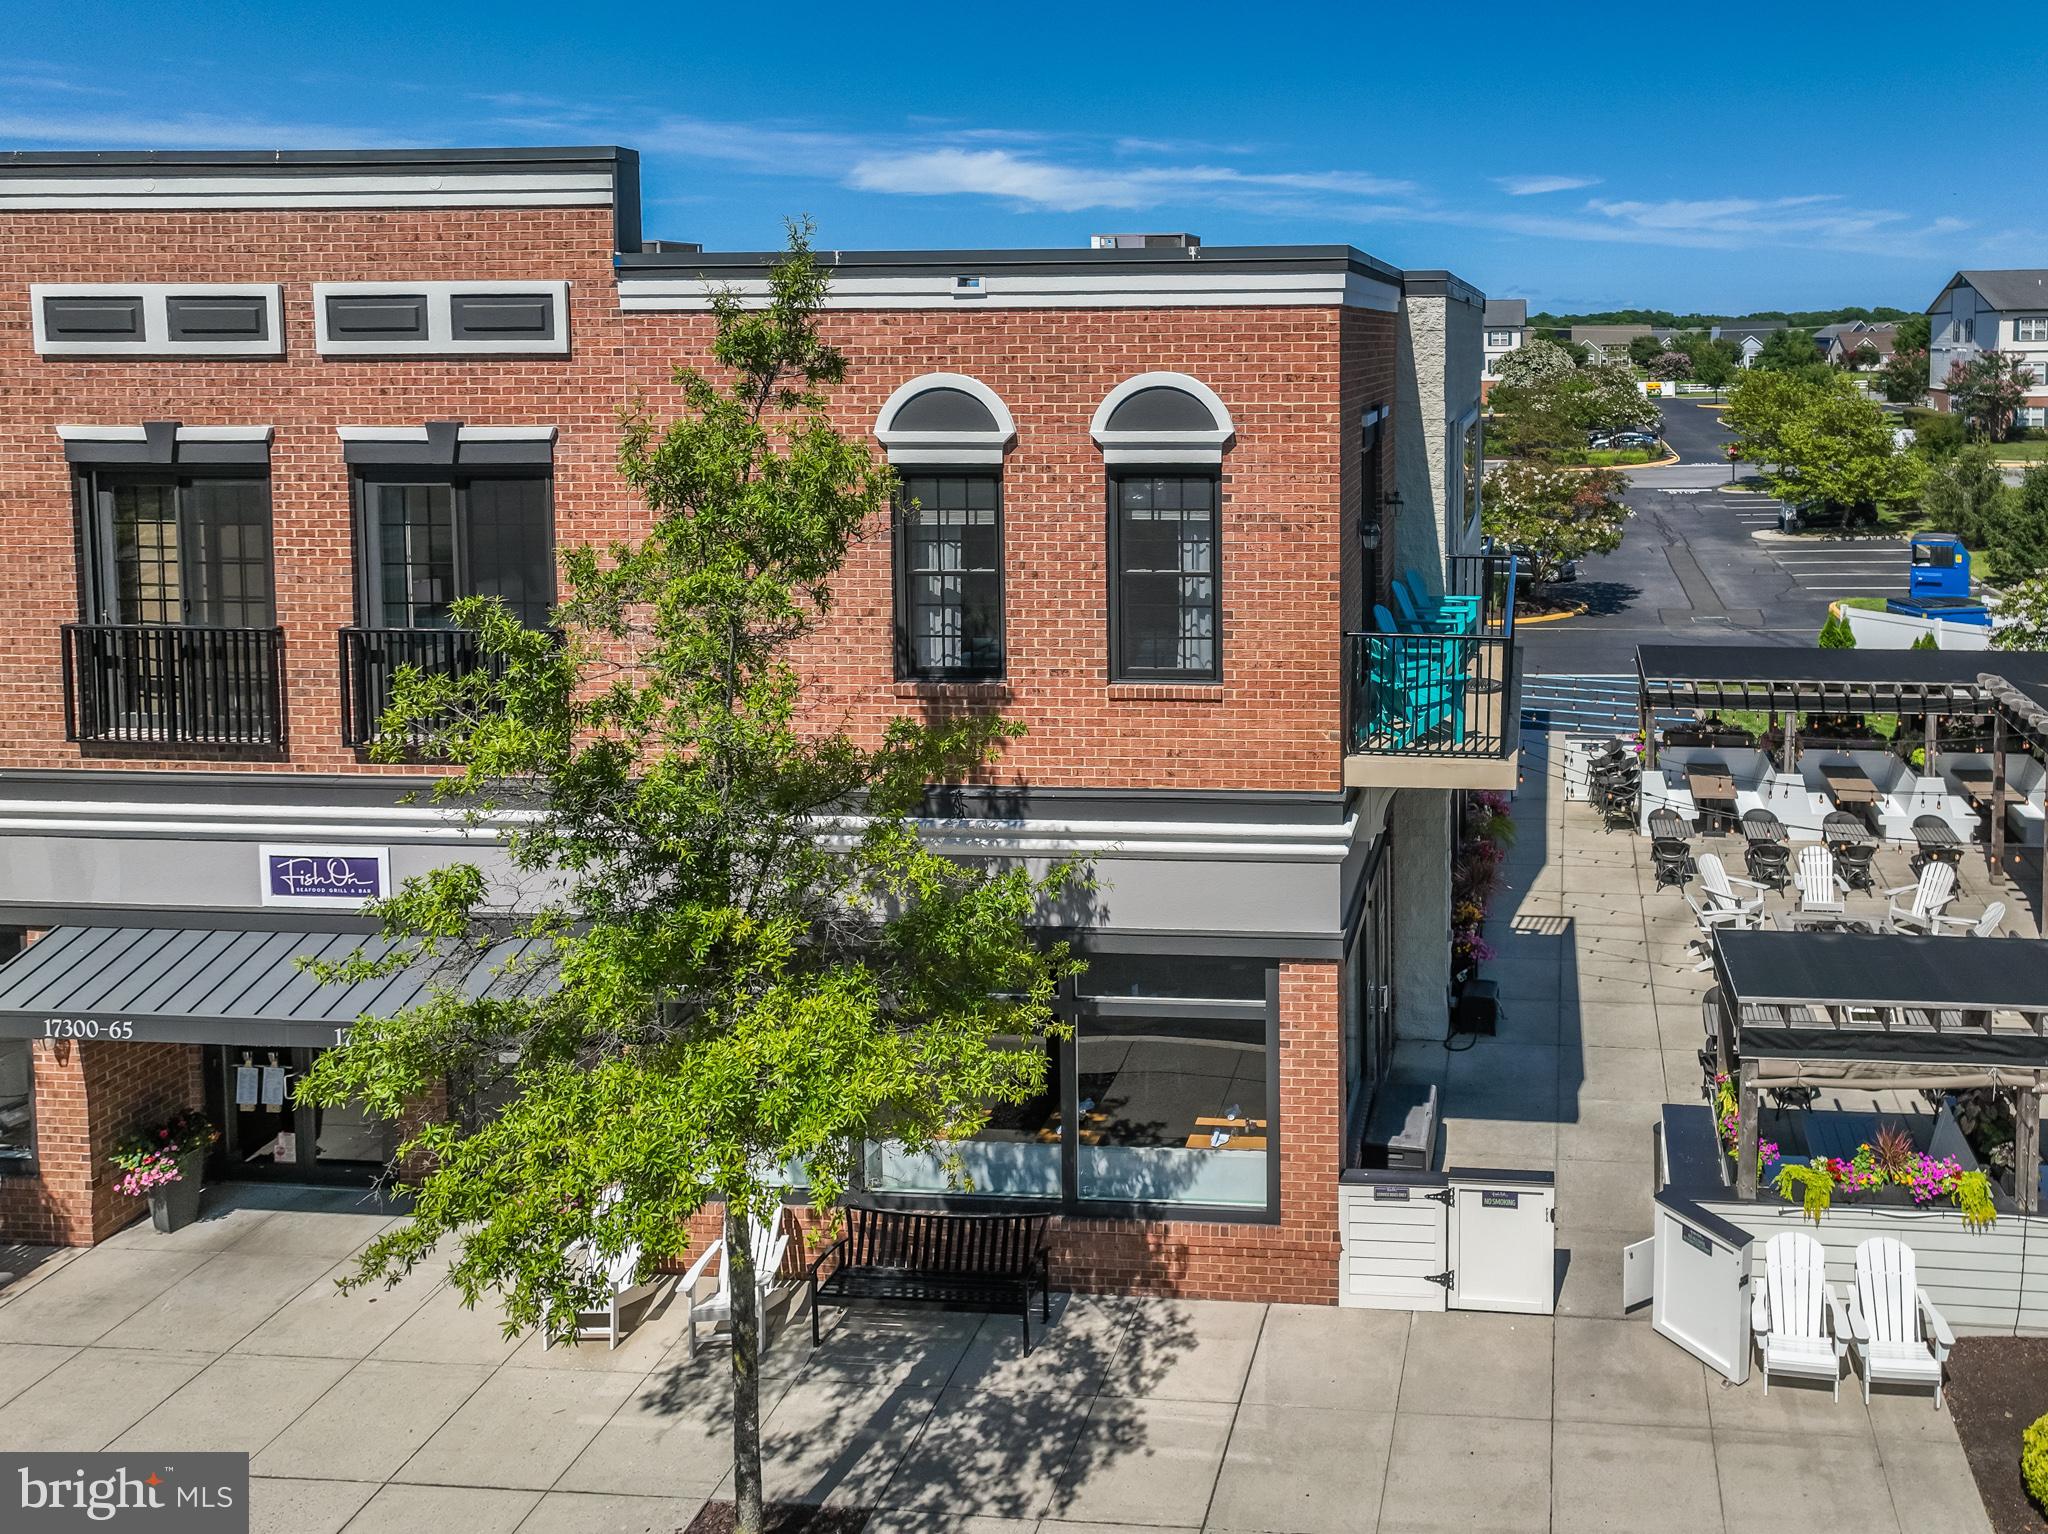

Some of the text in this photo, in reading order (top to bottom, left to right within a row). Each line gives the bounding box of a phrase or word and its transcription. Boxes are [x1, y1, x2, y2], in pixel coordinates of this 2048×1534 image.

[43, 1019, 133, 1039] 17300-65
[1484, 1197, 1516, 1206] NO SMOKING
